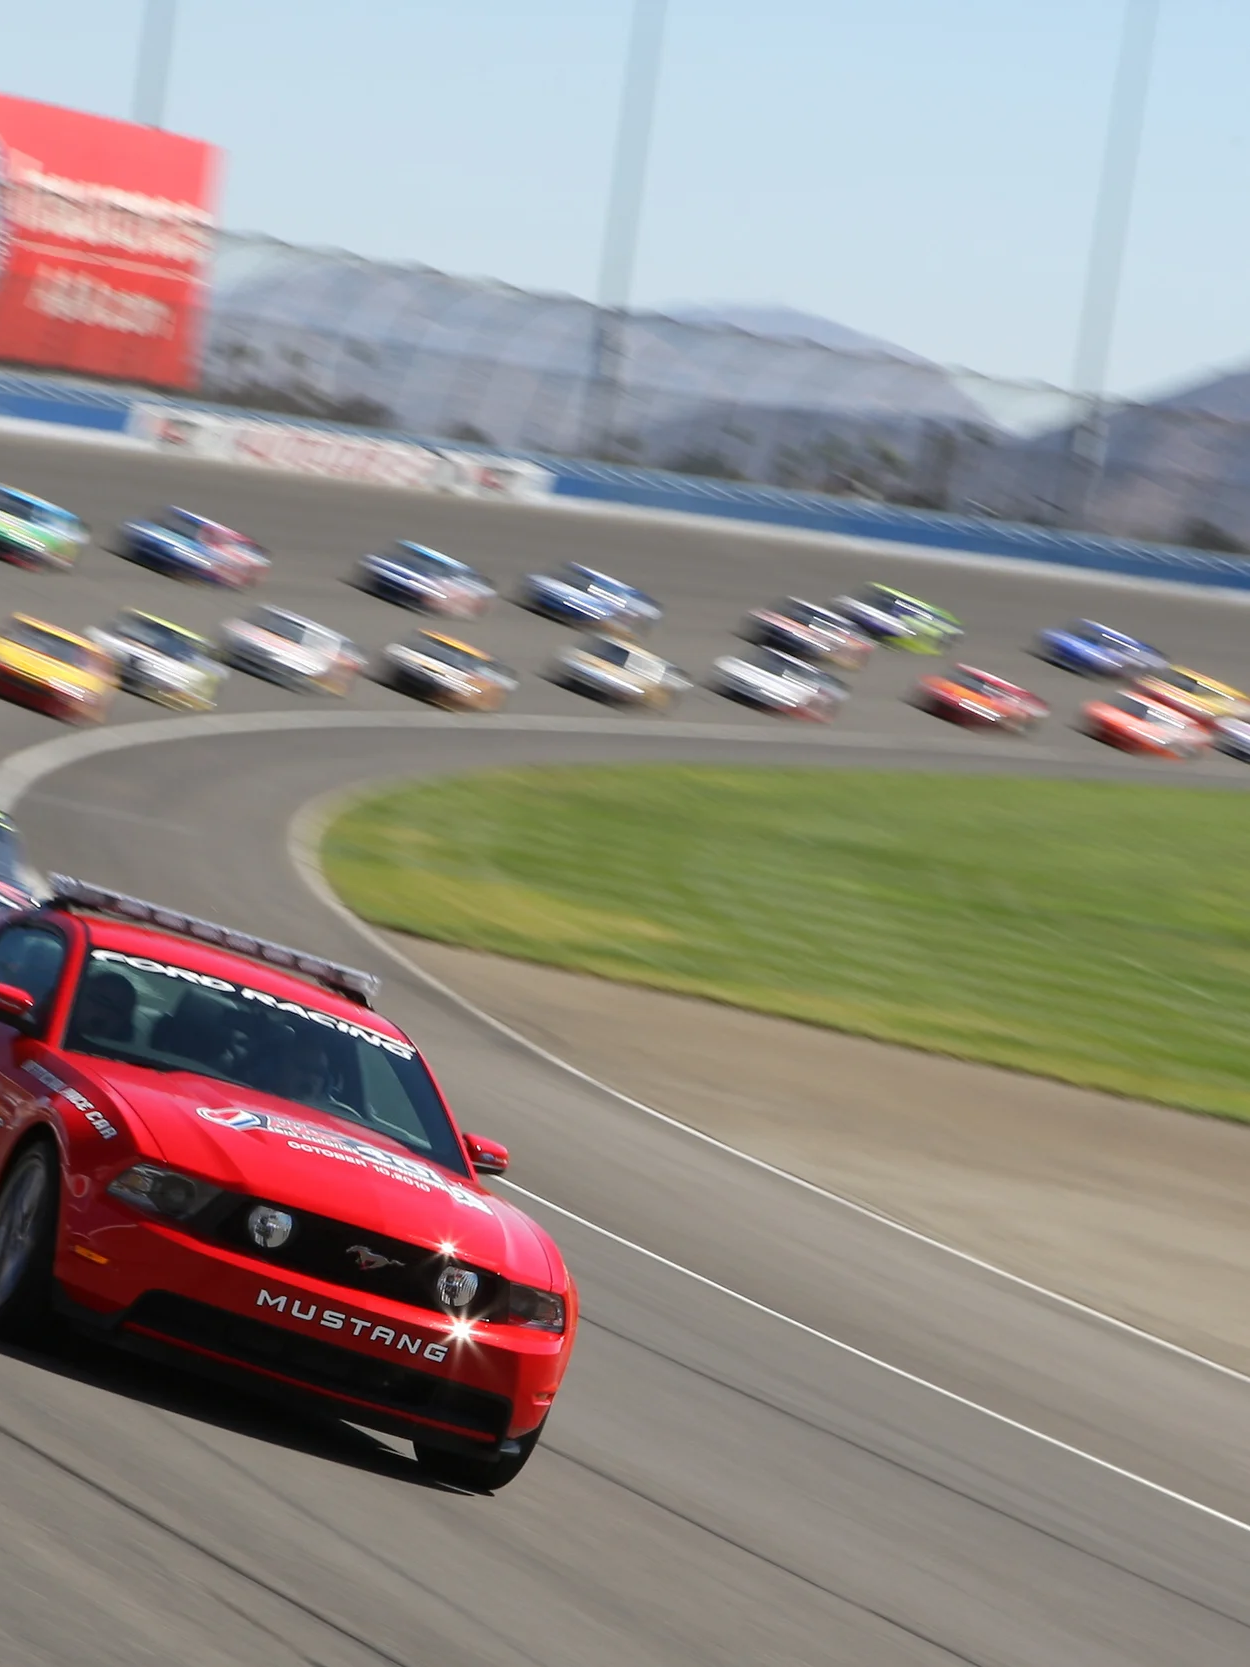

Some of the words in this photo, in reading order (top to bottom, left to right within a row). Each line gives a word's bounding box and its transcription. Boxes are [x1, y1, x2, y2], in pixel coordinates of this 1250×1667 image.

[90, 948, 236, 993] FORD
[239, 986, 417, 1062] RACING
[84, 1110, 118, 1140] CAR
[286, 1140, 368, 1169] OCTOBER
[256, 1289, 449, 1364] MUSTANG
